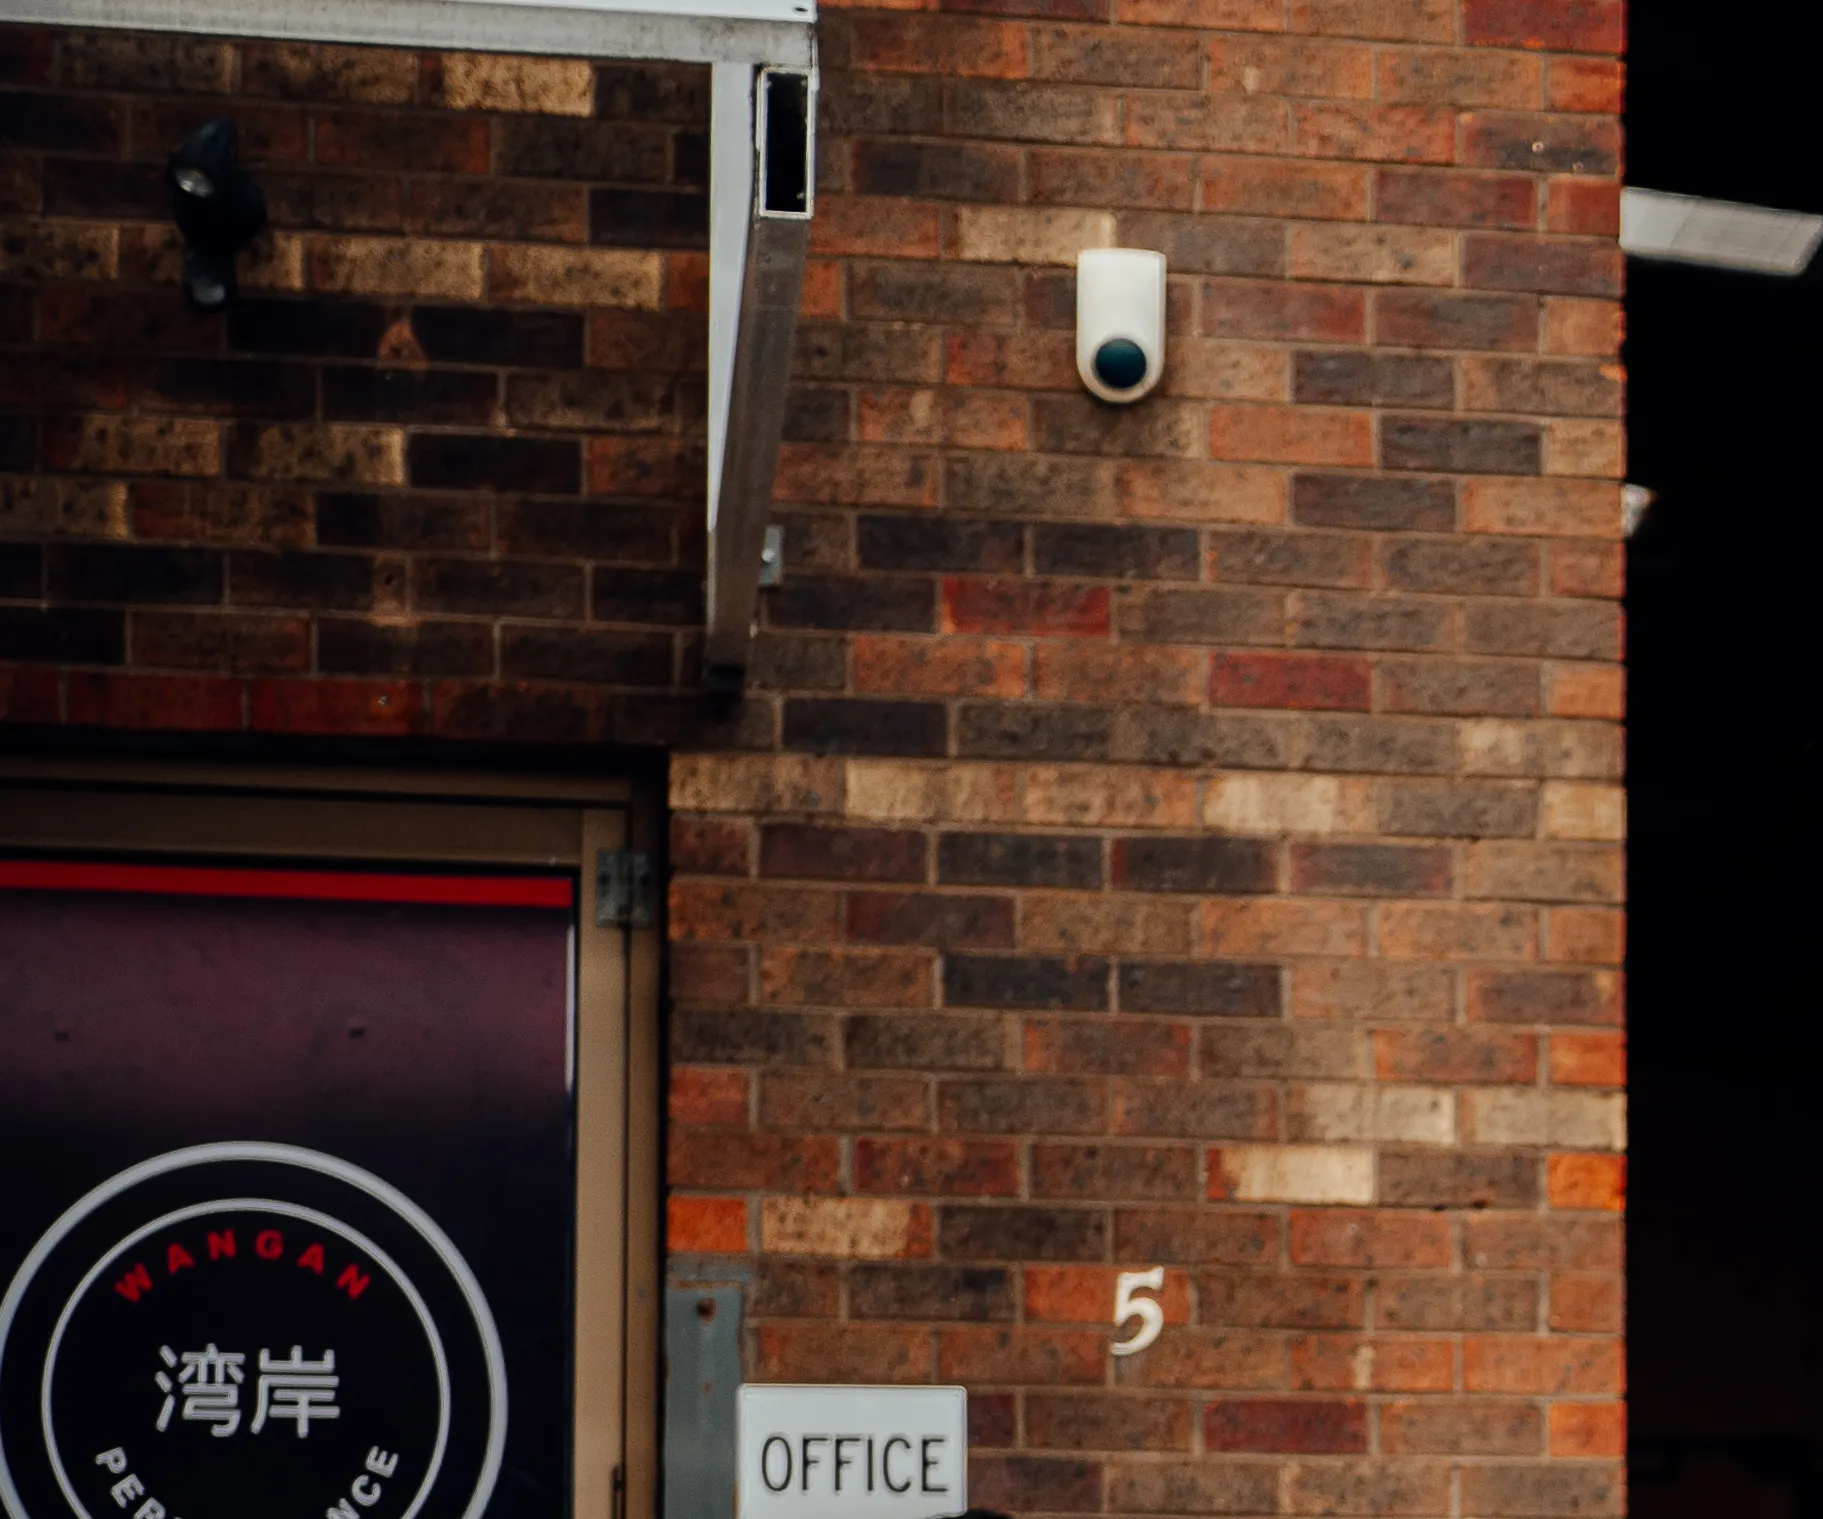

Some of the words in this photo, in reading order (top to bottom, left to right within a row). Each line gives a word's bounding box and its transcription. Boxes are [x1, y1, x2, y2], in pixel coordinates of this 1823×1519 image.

[111, 1228, 372, 1303] WANGAN
[1108, 1266, 1165, 1356] 5
[154, 1342, 341, 1440] 湾岸
[761, 1434, 949, 1493] OFFICE
